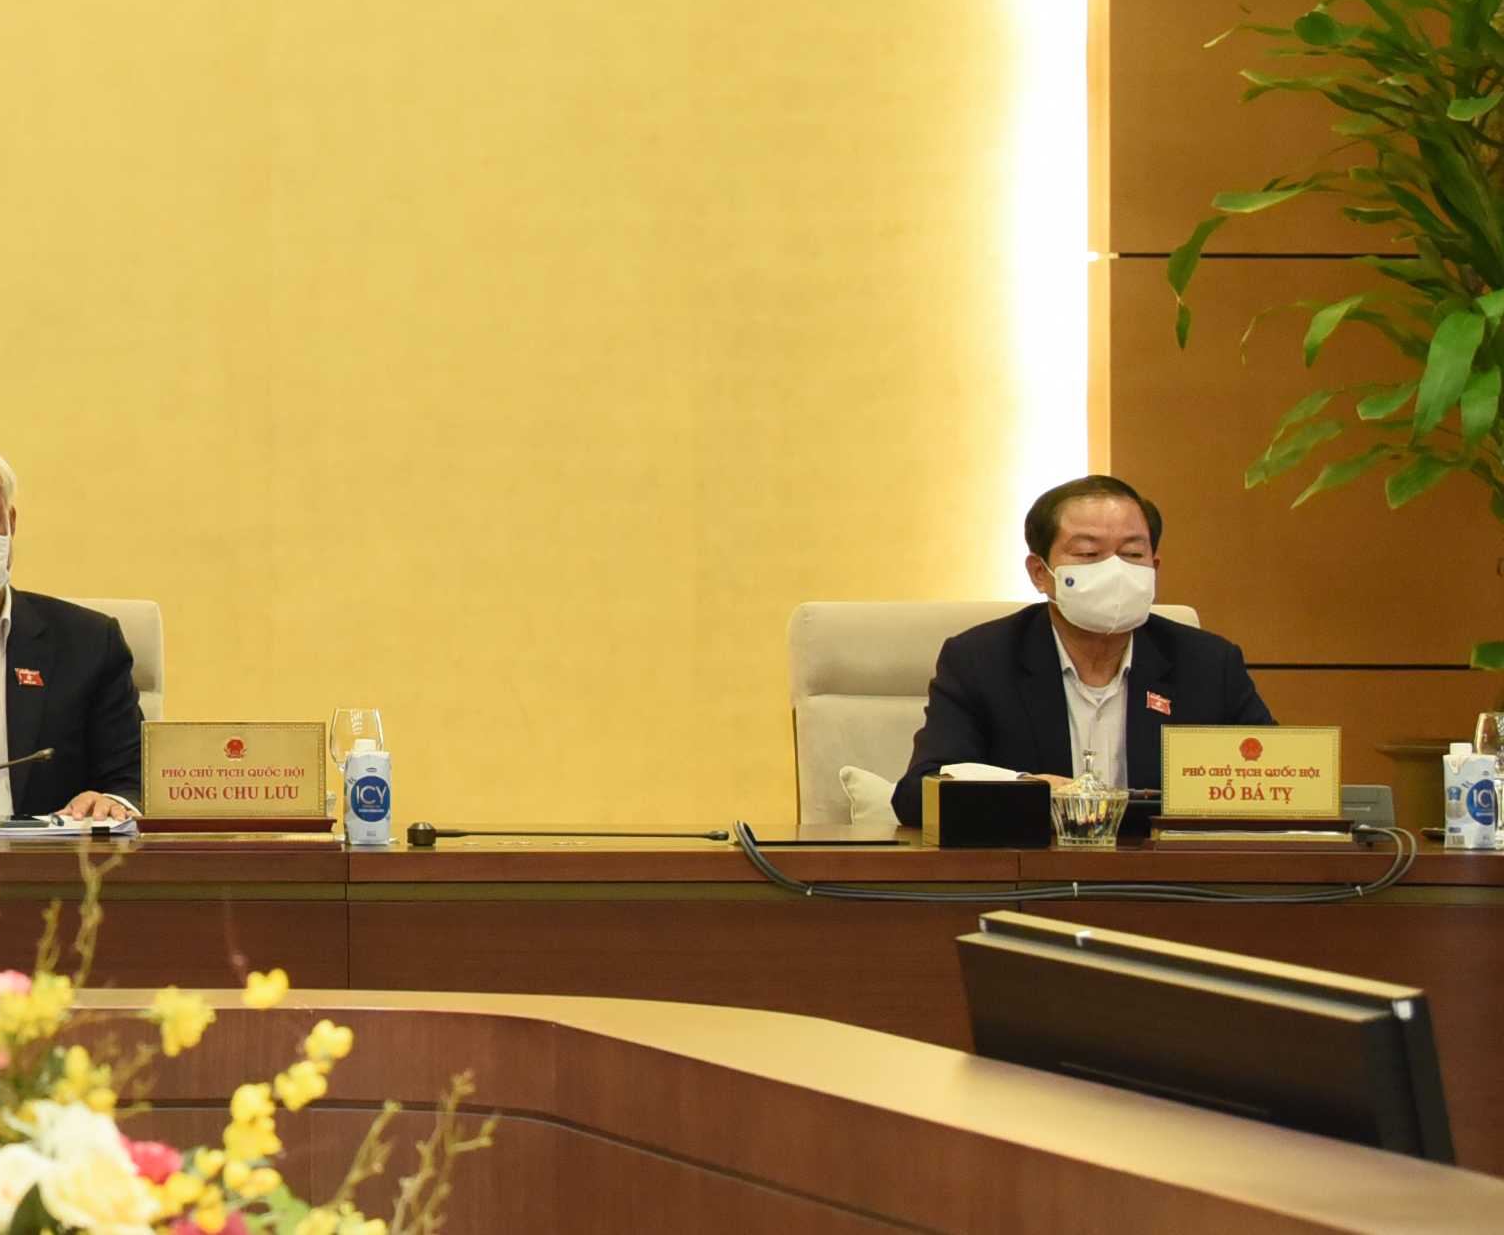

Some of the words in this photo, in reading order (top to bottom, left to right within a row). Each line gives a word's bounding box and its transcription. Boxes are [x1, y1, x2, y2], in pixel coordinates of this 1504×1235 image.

[162, 767, 186, 778] PHÓ
[189, 766, 213, 778] CHỦ
[216, 769, 245, 780] TỊCH
[247, 766, 281, 778] QUỐC
[283, 766, 305, 779] HỘI
[1182, 766, 1206, 777] PHÓ
[1208, 765, 1232, 777] CHỦ
[1235, 768, 1262, 779] TỊCH
[1265, 765, 1297, 777] QUỐC
[1299, 767, 1321, 779] HỘI
[168, 782, 218, 801] UÔNG
[222, 786, 259, 800] CHU
[263, 783, 300, 800] LƯU
[356, 785, 387, 805] ICY
[1208, 779, 1236, 801] ĐỖ
[1240, 782, 1266, 801] BÁ
[1269, 786, 1293, 805] TỴ
